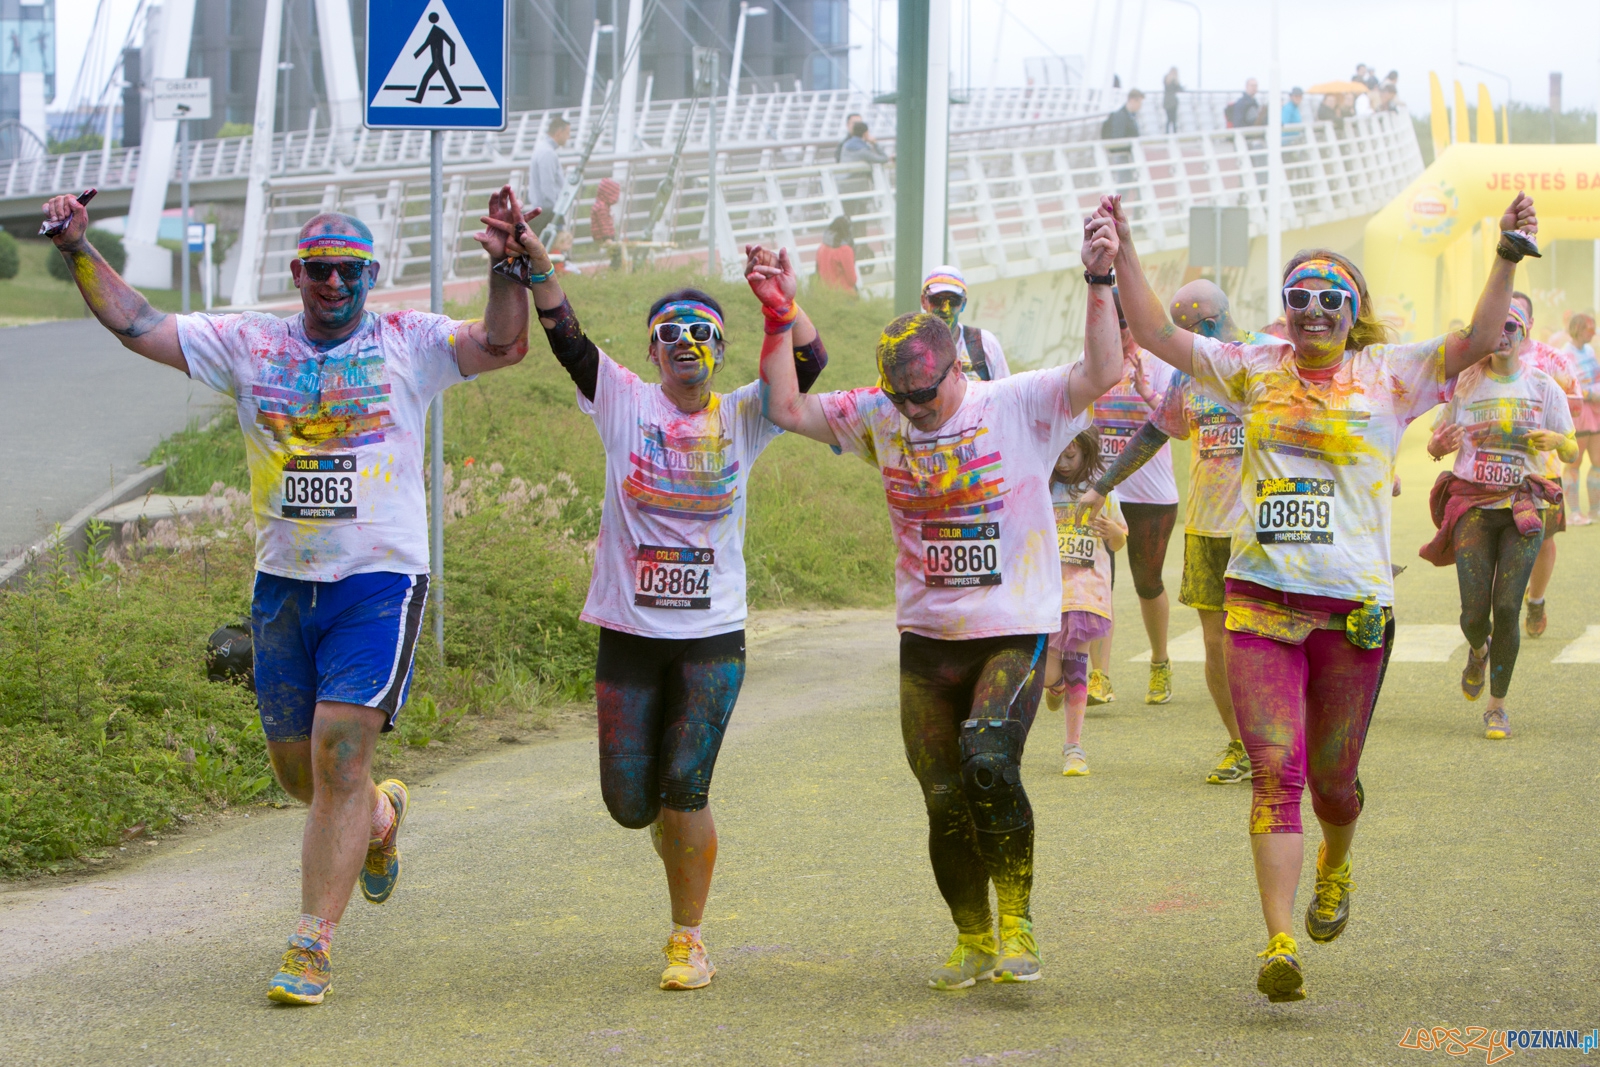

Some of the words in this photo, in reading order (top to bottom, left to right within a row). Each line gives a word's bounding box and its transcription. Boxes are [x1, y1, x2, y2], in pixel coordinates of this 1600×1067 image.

[1486, 167, 1566, 190] JESTEŚ
[642, 438, 662, 465] THE
[662, 448, 704, 471] COLOR
[296, 459, 319, 470] COLOR
[319, 460, 334, 470] RUN
[285, 476, 353, 504] 03863
[1296, 482, 1312, 493] RUN
[300, 508, 336, 517] #HAPPIEST5K
[1258, 499, 1330, 529] 03859
[939, 527, 962, 538] COLOR
[962, 527, 977, 538] RUN
[656, 550, 680, 561] COLOR
[926, 544, 997, 573] 03860
[640, 565, 710, 595] 03864
[943, 576, 981, 586] #HAPPIEST5K
[655, 599, 692, 608] #HAPPIEST5K
